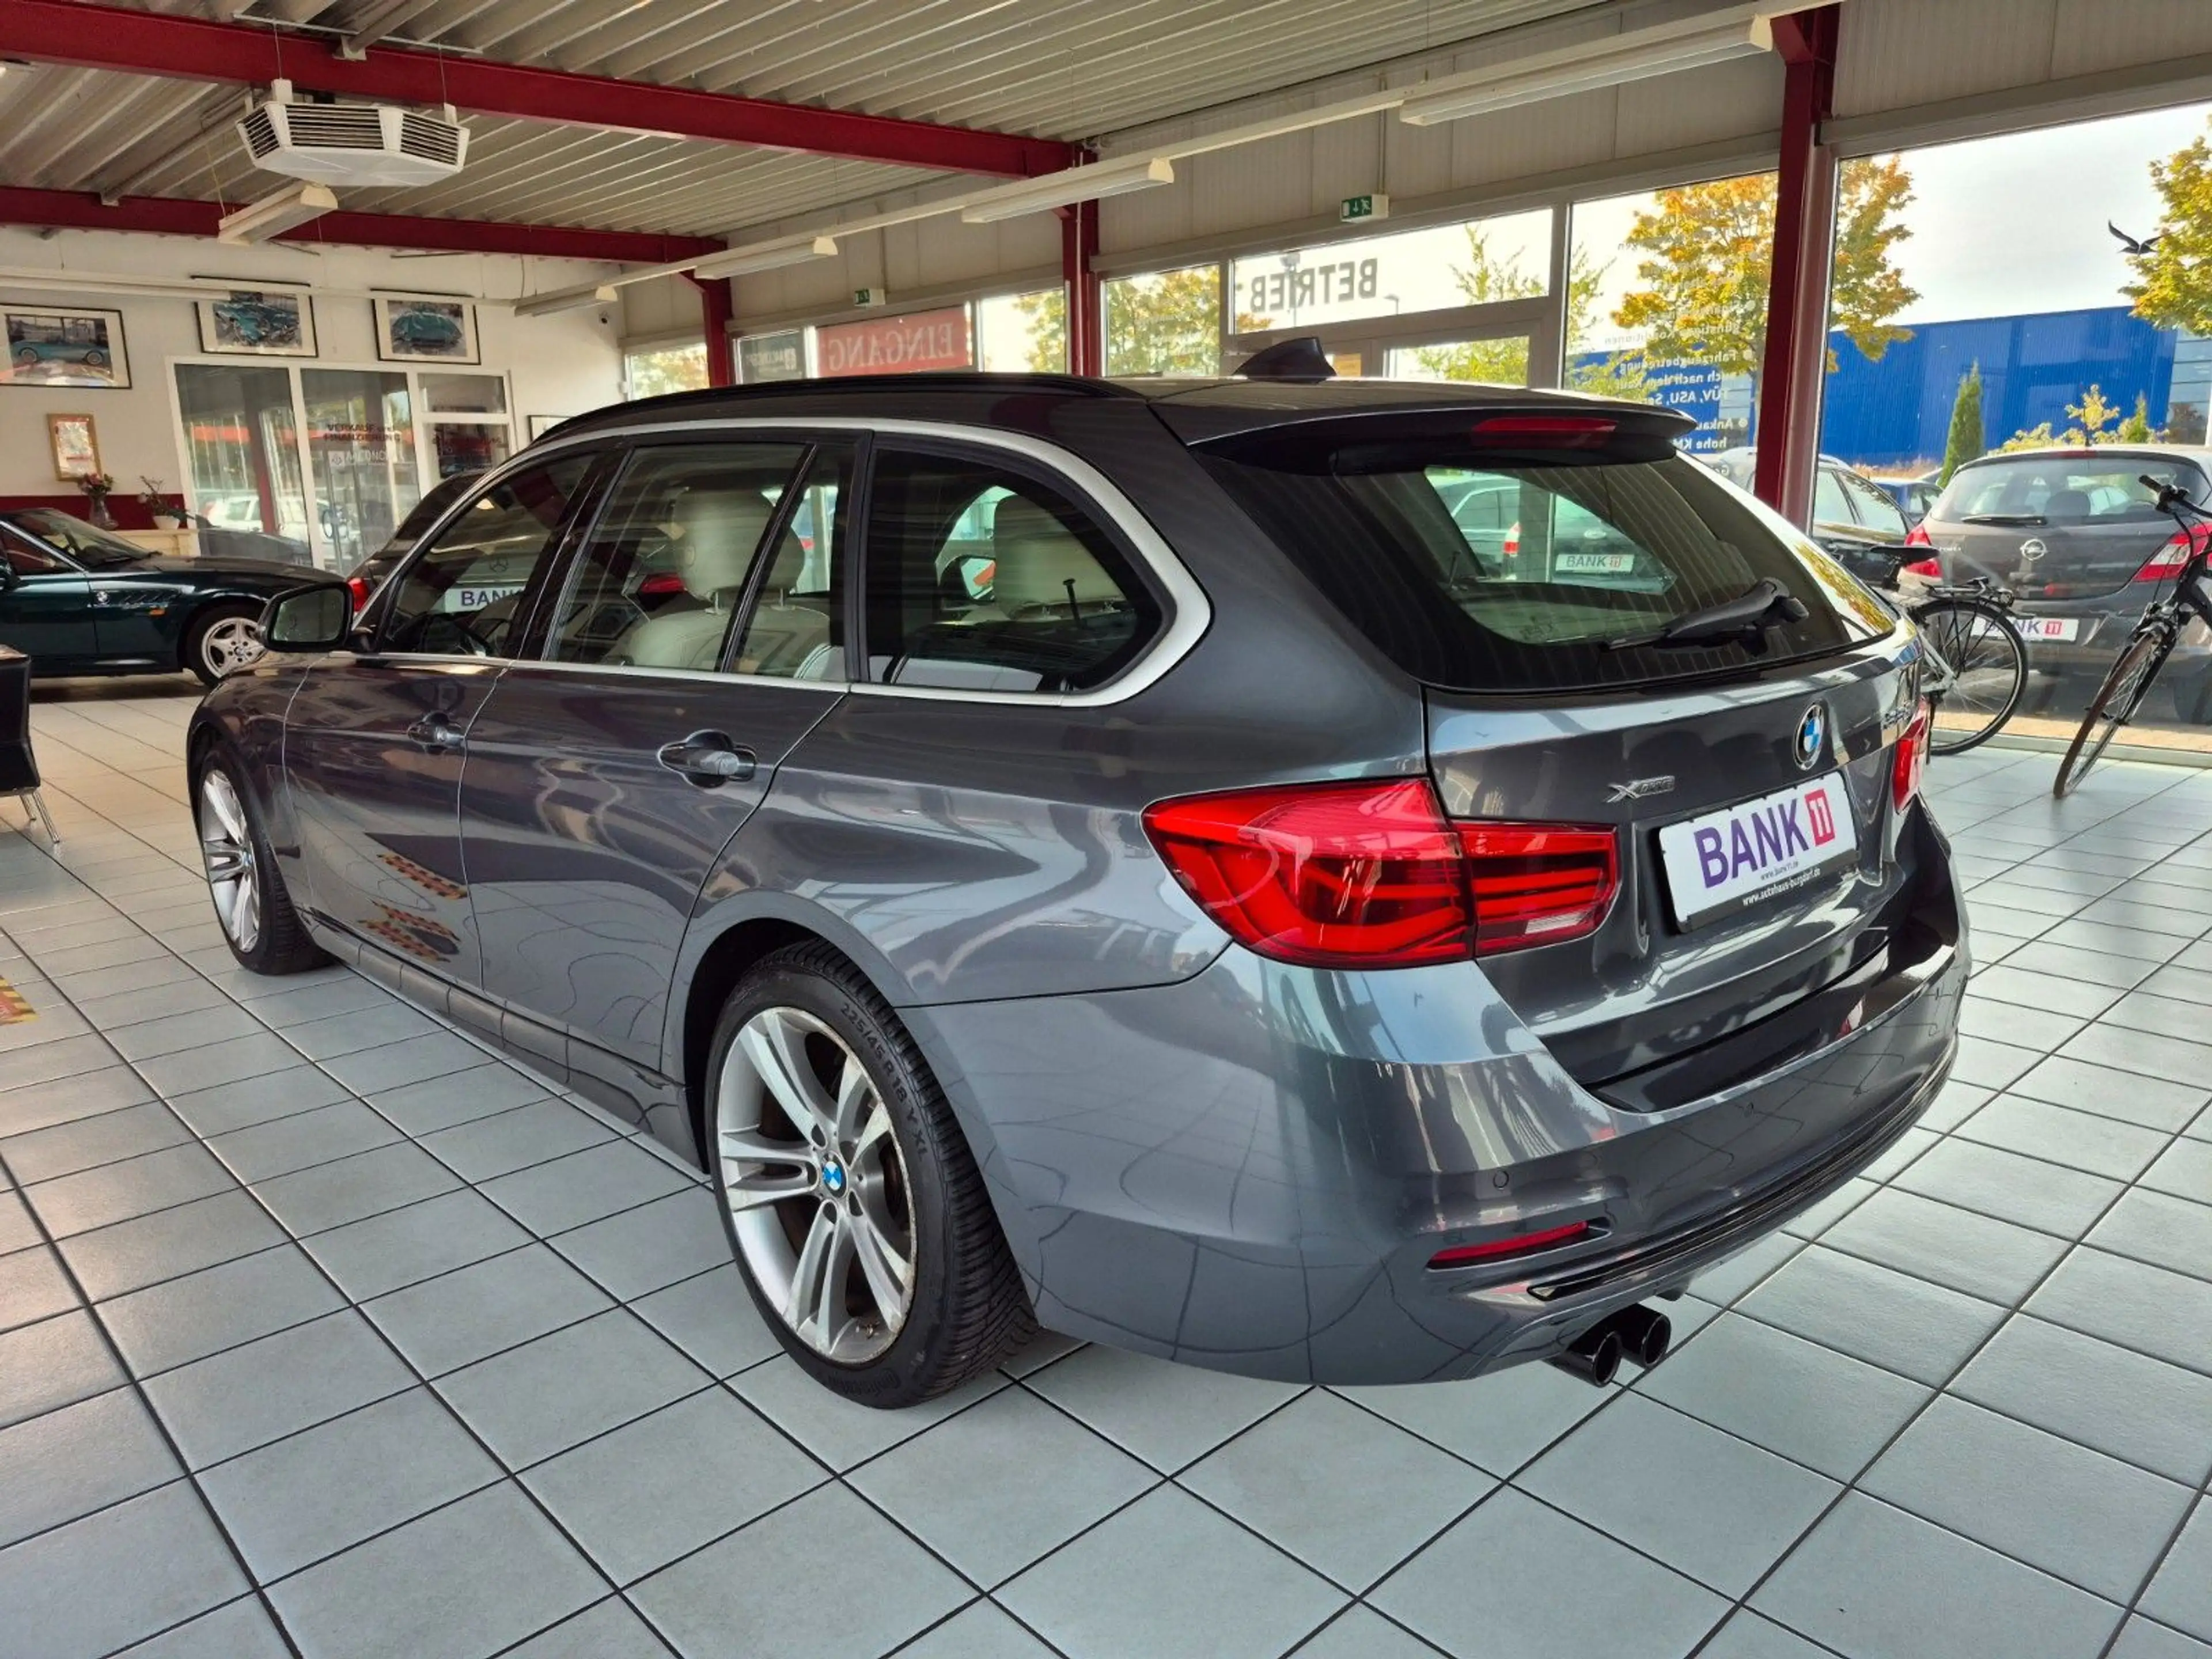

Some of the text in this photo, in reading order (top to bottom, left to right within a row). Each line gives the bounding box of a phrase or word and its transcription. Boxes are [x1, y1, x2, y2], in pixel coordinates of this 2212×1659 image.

[1566, 555, 1606, 567] BANK
[1694, 794, 1833, 888] BANK 11
[840, 1002, 885, 1059] 225/45
